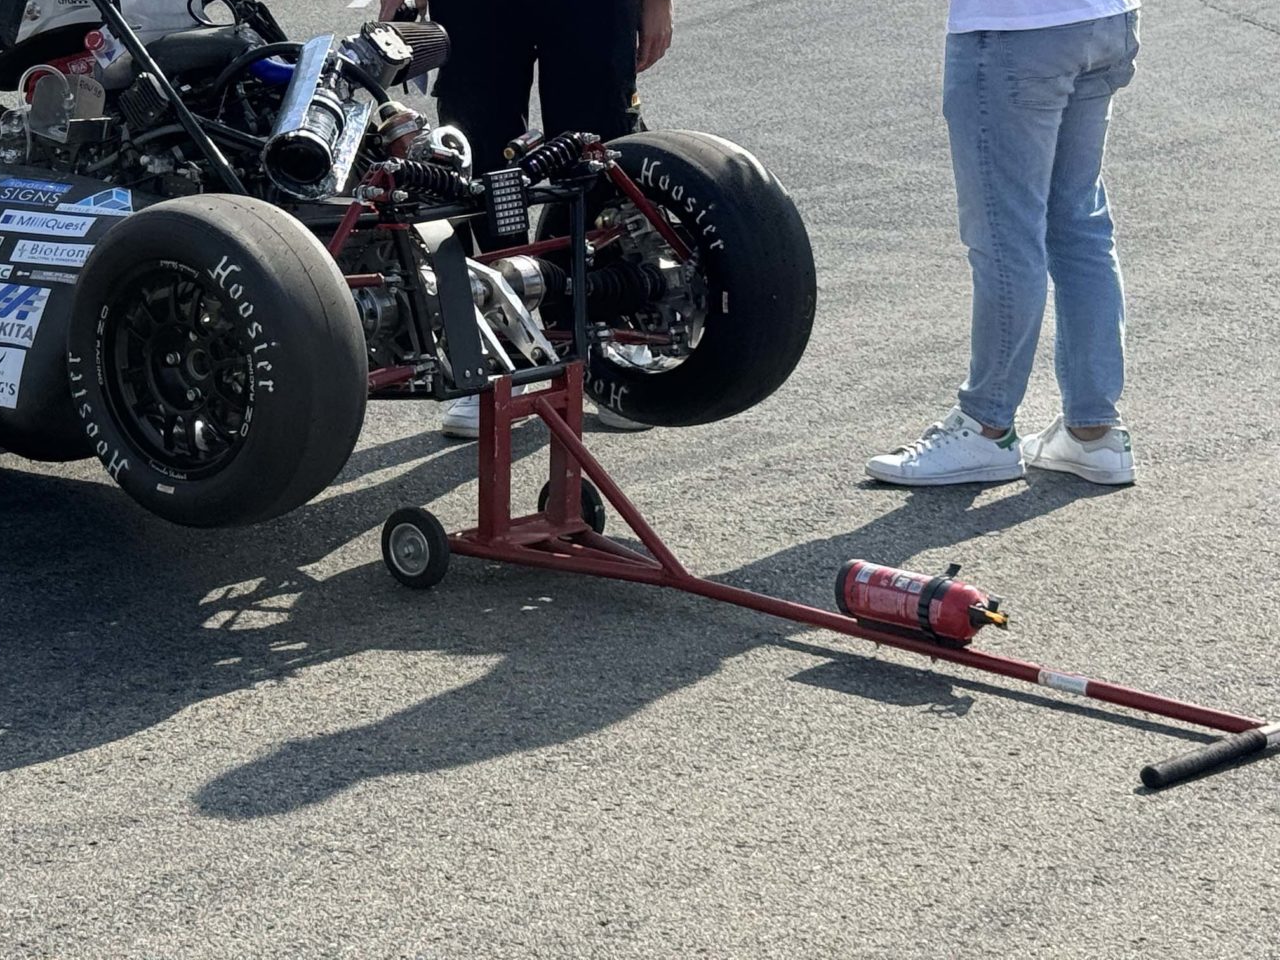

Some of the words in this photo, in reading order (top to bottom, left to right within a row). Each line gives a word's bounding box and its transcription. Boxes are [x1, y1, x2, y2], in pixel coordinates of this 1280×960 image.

[0, 187, 62, 205] SIGNS
[636, 157, 725, 250] Hoosier
[16, 216, 87, 232] MilliQuest
[29, 243, 92, 258] Biotroni
[208, 255, 278, 393] Hoosier
[69, 352, 130, 481] Hoosier
